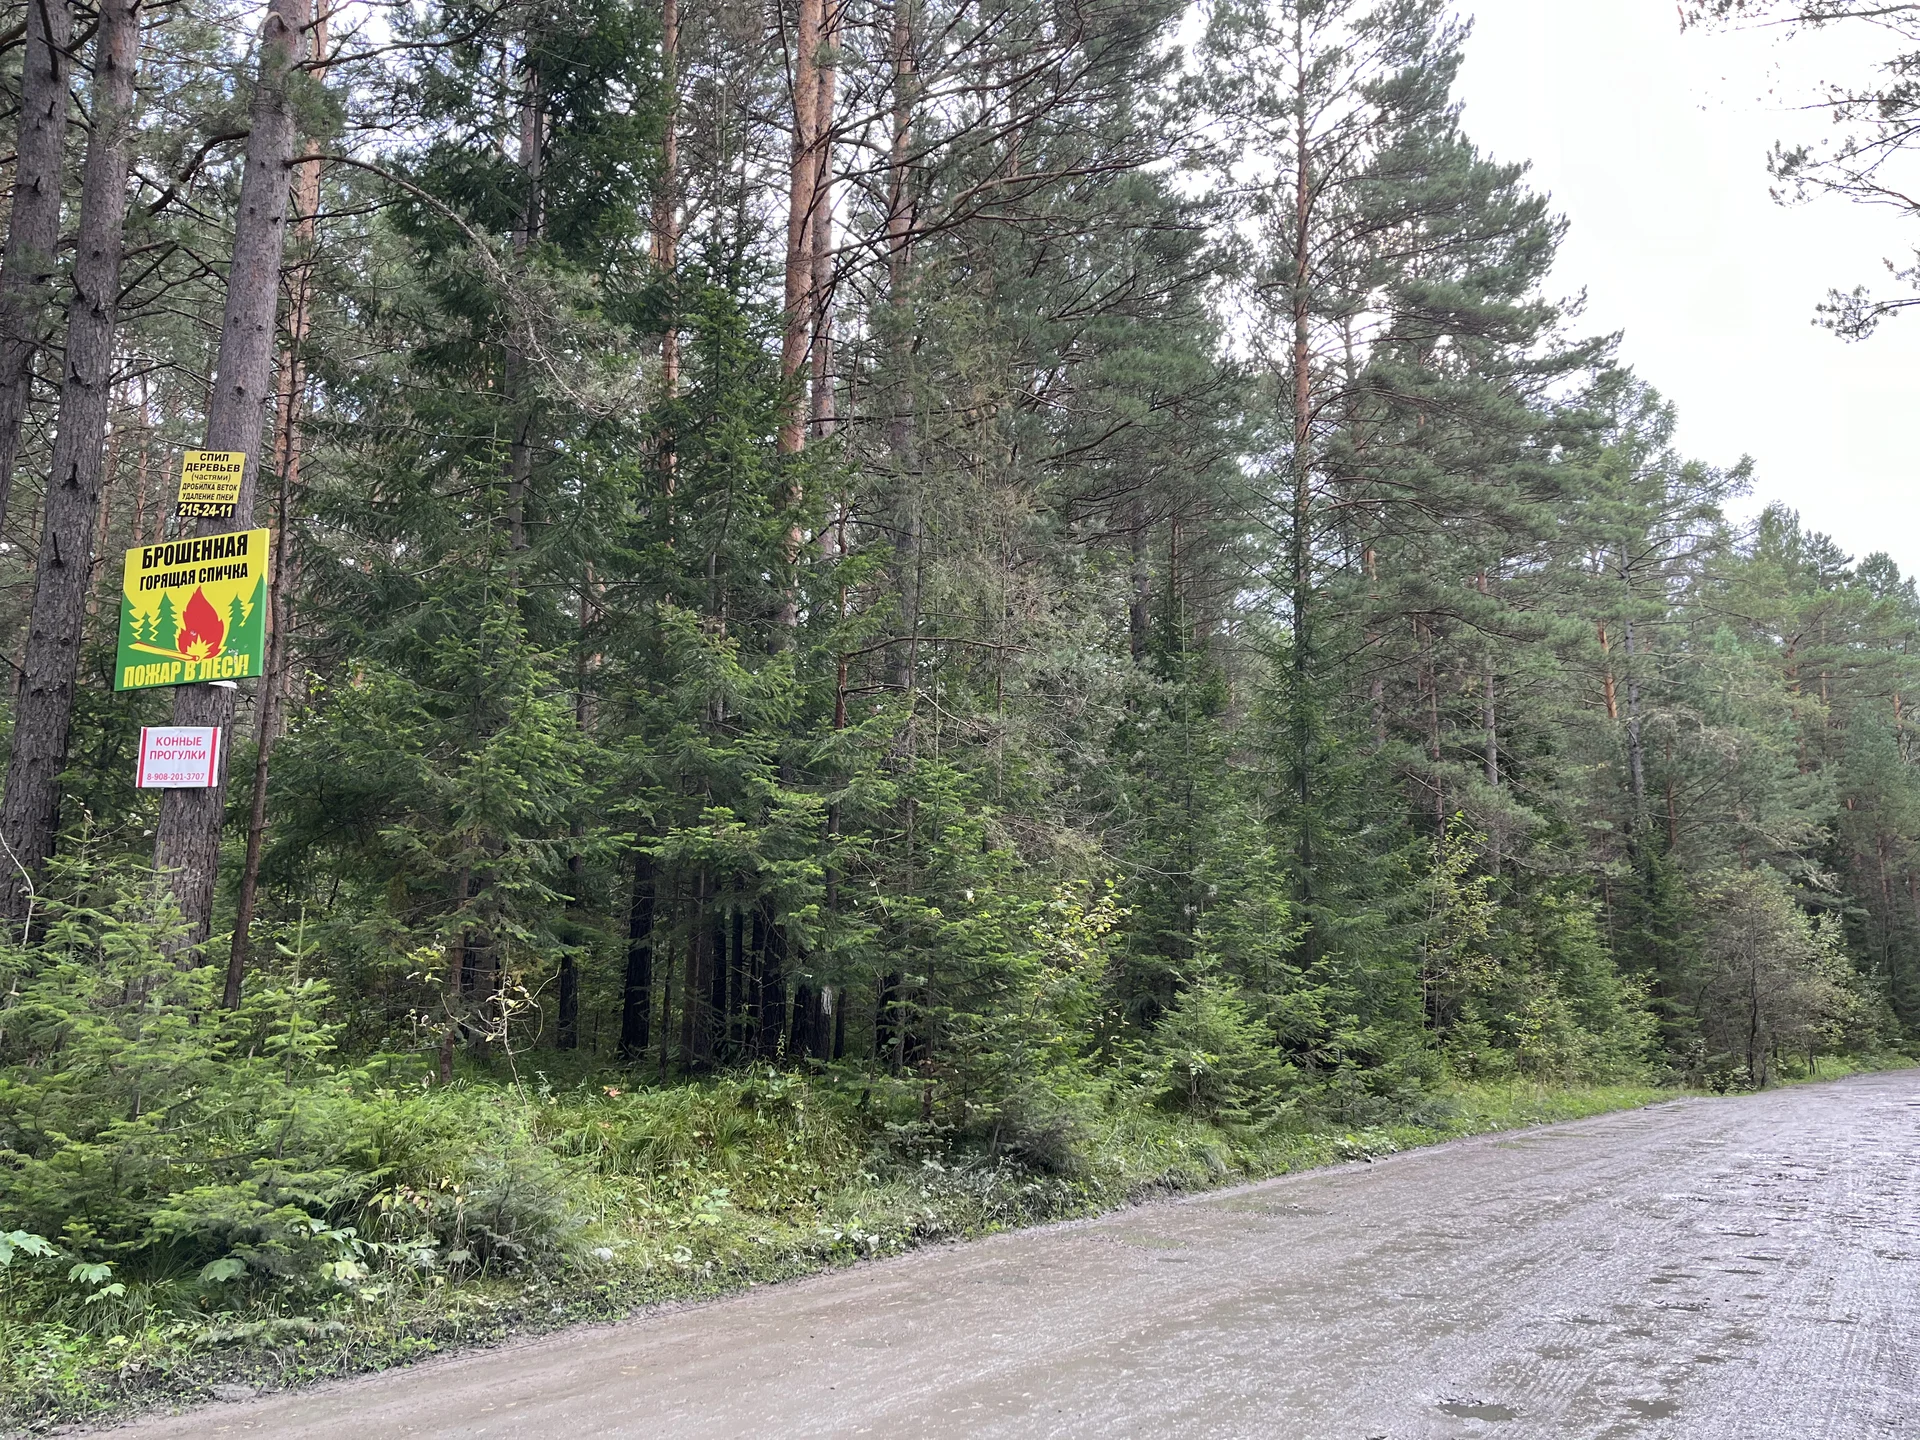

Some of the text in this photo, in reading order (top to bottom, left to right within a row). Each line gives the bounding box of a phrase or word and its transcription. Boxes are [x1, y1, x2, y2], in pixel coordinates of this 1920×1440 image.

[200, 453, 229, 461] СПИЛ
[185, 463, 240, 472] ДЕРЕВЬЕВ
[192, 473, 231, 482] (частями)
[179, 503, 232, 517] 215-24-11
[142, 534, 248, 569] БРОШЕННАЯ
[140, 563, 248, 591] ГОРЯЩАЯ СПИЧКА
[123, 654, 249, 687] ПОЖАР В ЛЕСУ!
[156, 736, 202, 746] КОННЫЕ
[149, 750, 206, 760] ПРОГУЛКИ
